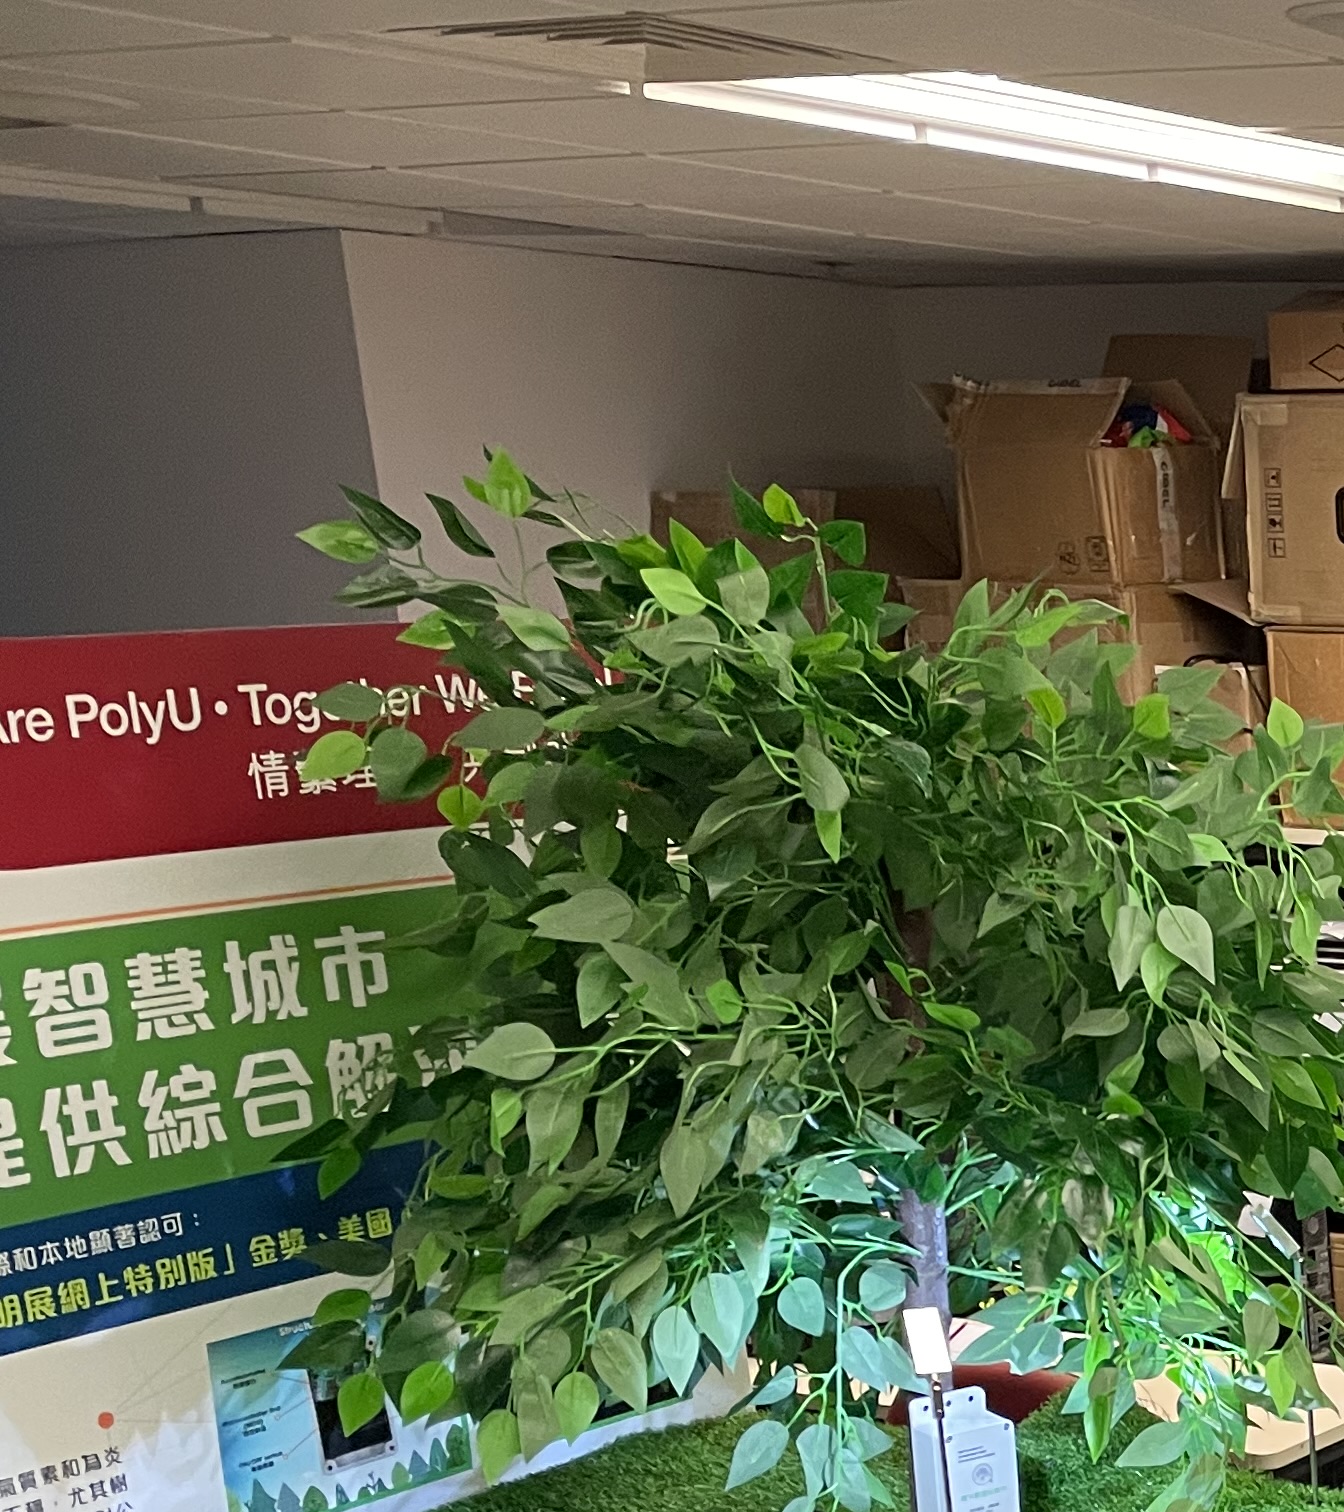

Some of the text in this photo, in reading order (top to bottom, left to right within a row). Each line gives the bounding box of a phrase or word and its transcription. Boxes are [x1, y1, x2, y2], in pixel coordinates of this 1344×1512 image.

[66, 686, 201, 746] PolyU
[237, 678, 422, 733] Toger
[0, 925, 390, 1066] 智慧城市
